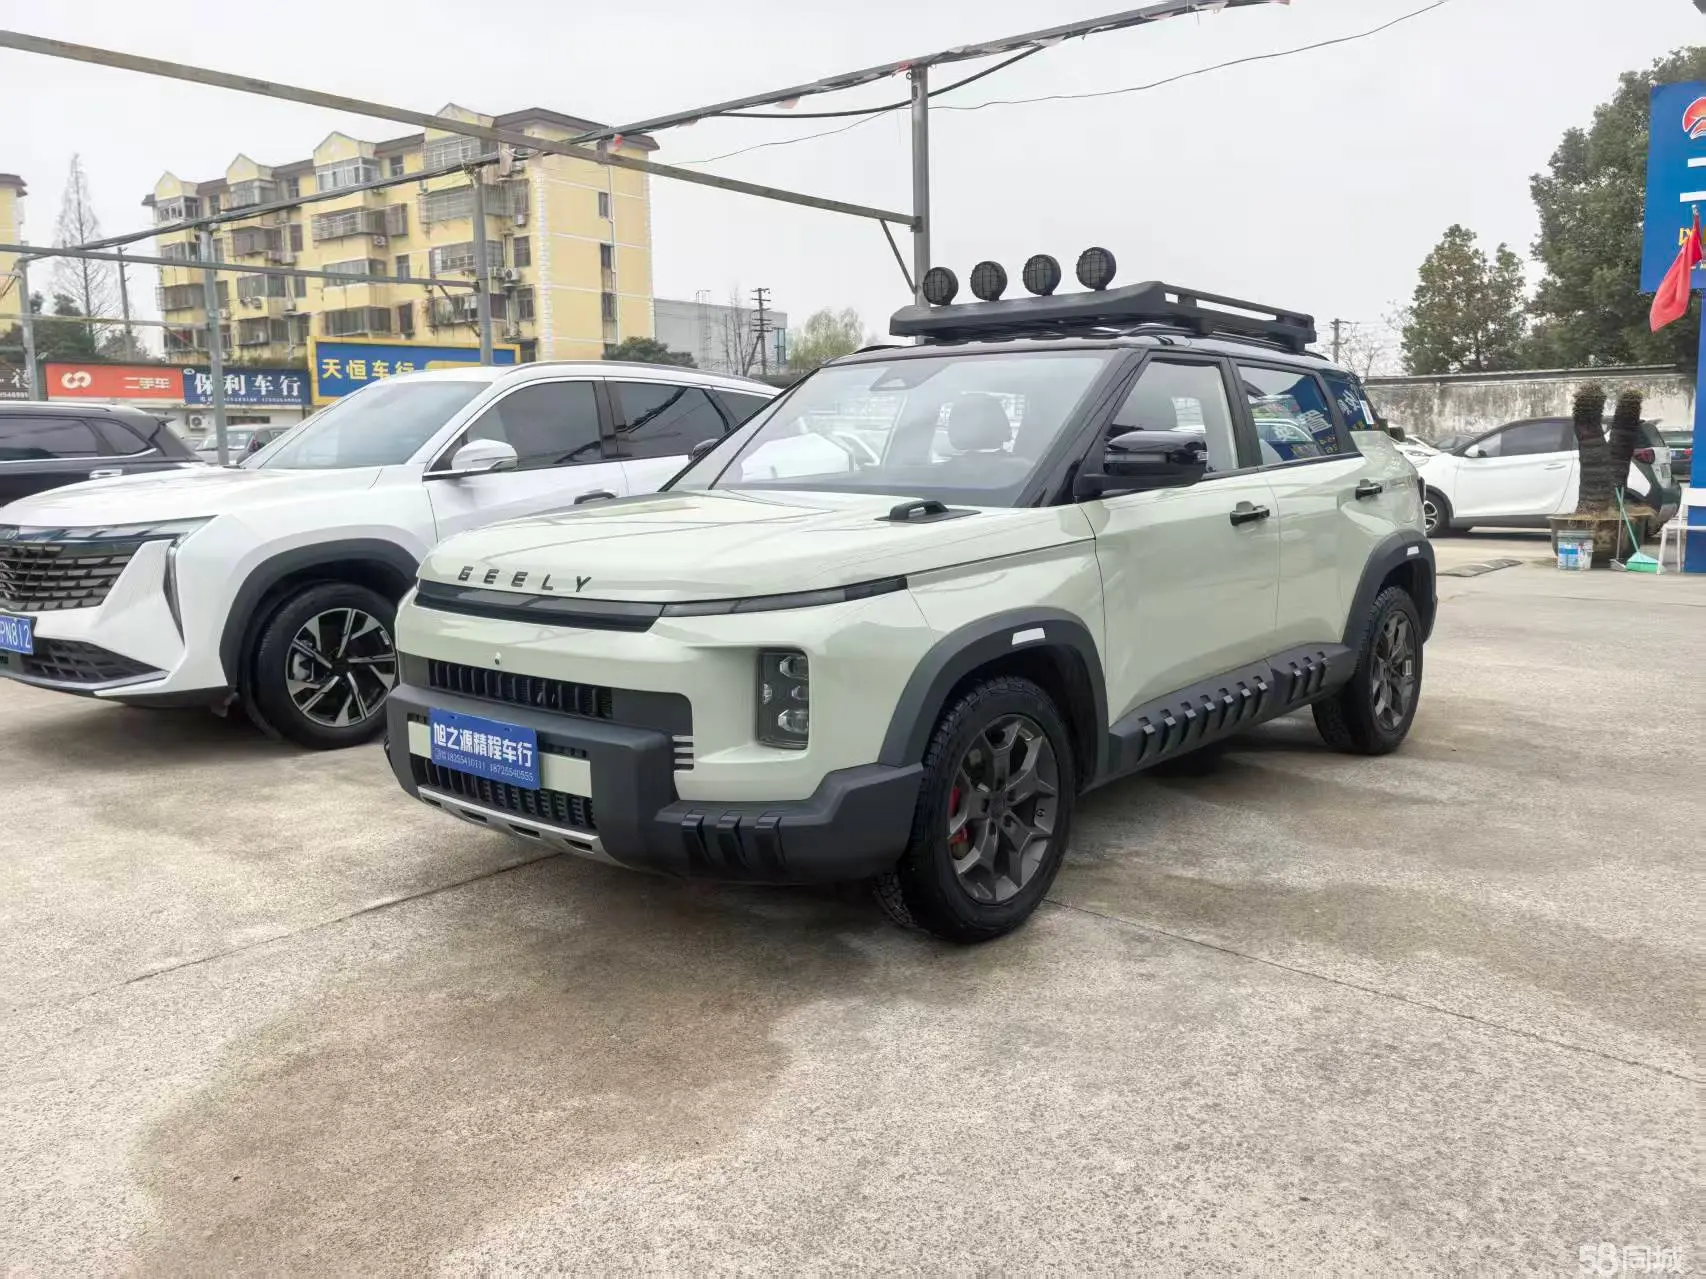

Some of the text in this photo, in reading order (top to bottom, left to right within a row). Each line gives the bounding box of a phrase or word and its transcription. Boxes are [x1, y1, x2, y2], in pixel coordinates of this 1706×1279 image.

[322, 358, 415, 381] 天恒车行
[195, 373, 301, 396] 保利车行
[458, 566, 592, 592] GEELY
[433, 722, 532, 768] 旭之源精程车行
